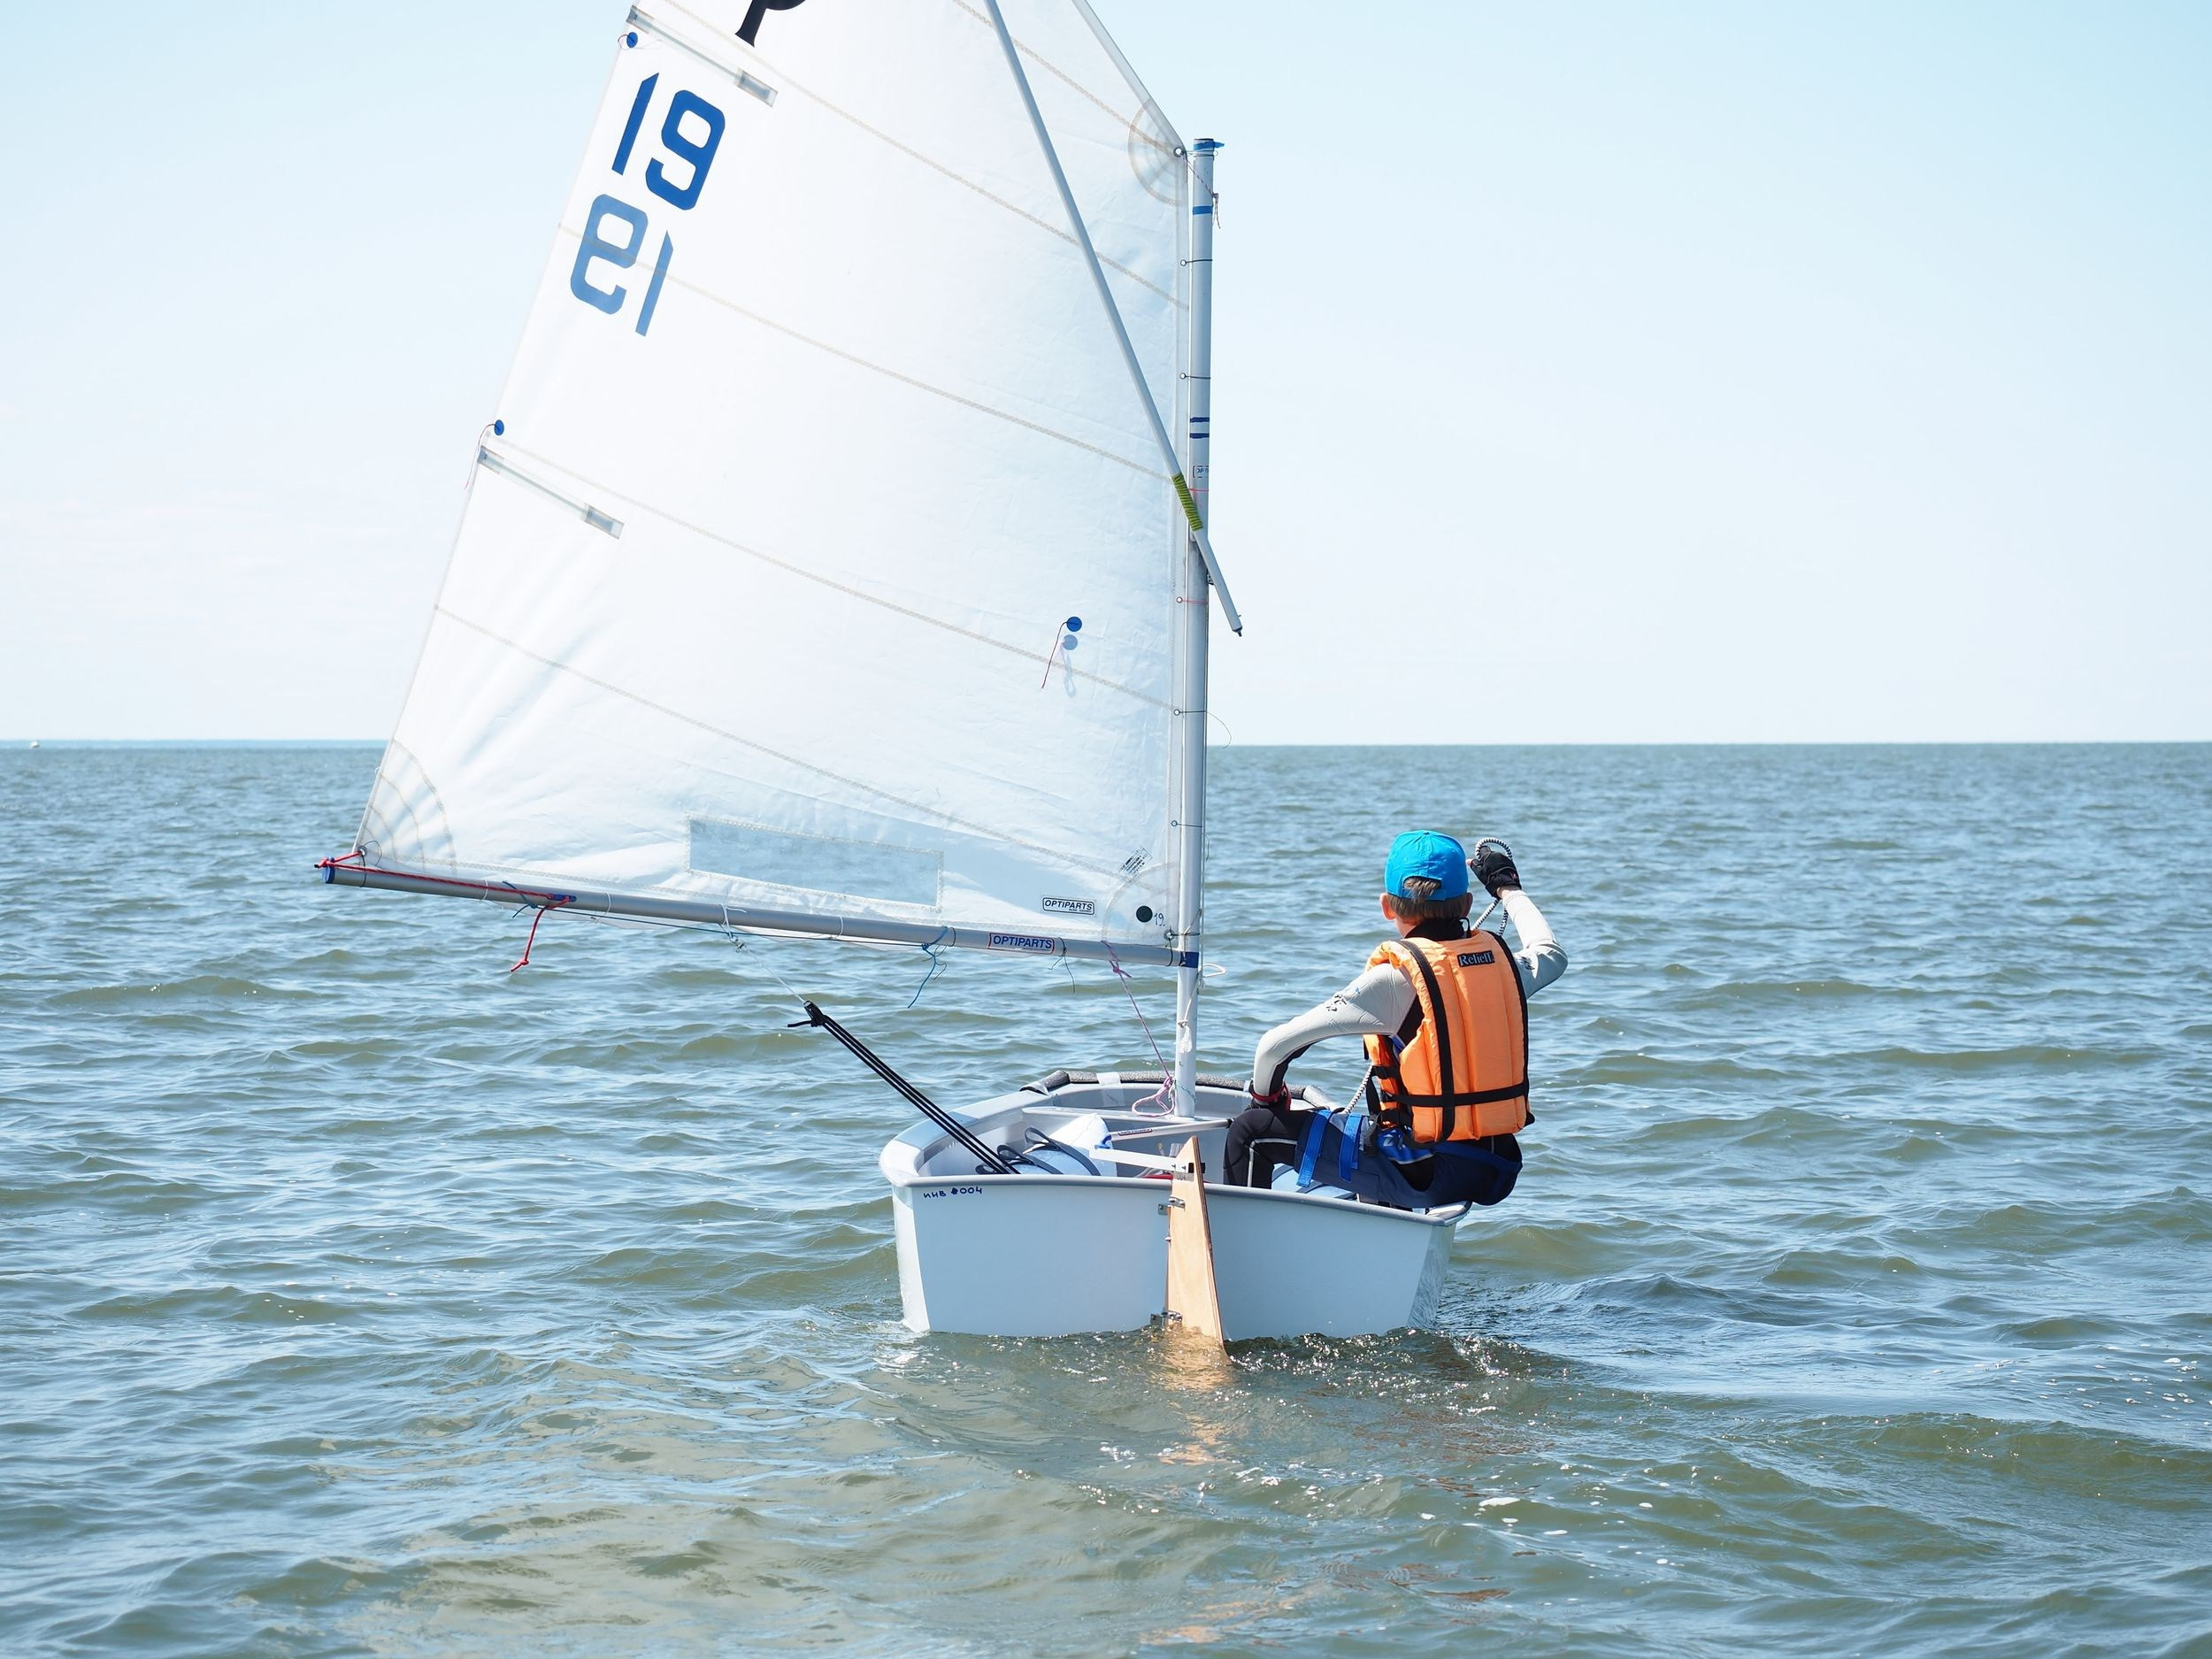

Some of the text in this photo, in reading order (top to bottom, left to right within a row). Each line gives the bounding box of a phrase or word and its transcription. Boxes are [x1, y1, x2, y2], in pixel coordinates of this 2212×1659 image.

[611, 73, 726, 211] 19
[1045, 900, 1093, 910] OPTIPARTS
[993, 935, 1052, 949] OPTIPARTS
